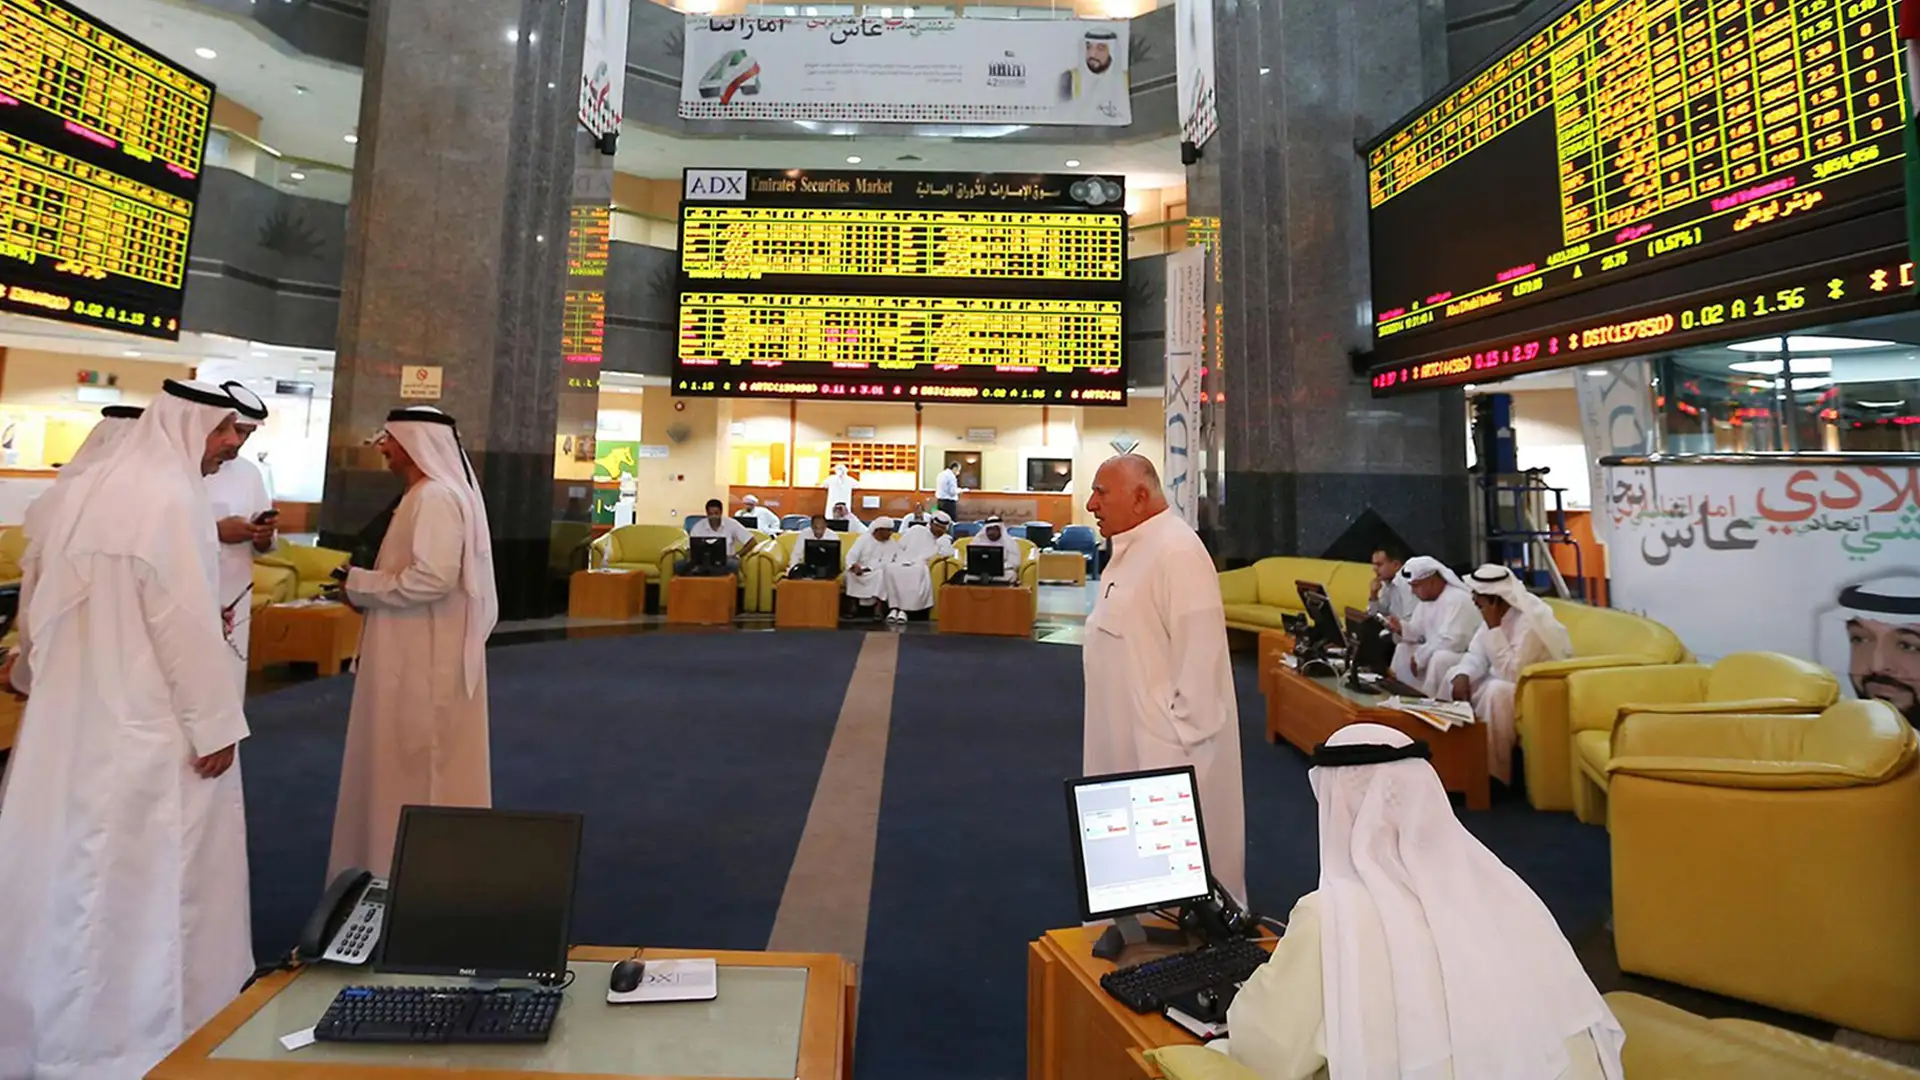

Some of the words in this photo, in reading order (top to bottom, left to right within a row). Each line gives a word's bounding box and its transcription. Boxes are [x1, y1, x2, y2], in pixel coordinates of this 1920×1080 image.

[691, 177, 742, 194] ADX
[751, 177, 796, 192] Emirates
[800, 176, 850, 193] Securities
[855, 178, 893, 194] Market
[1681, 304, 1724, 330] 0.02
[1752, 287, 1805, 316] 1.56
